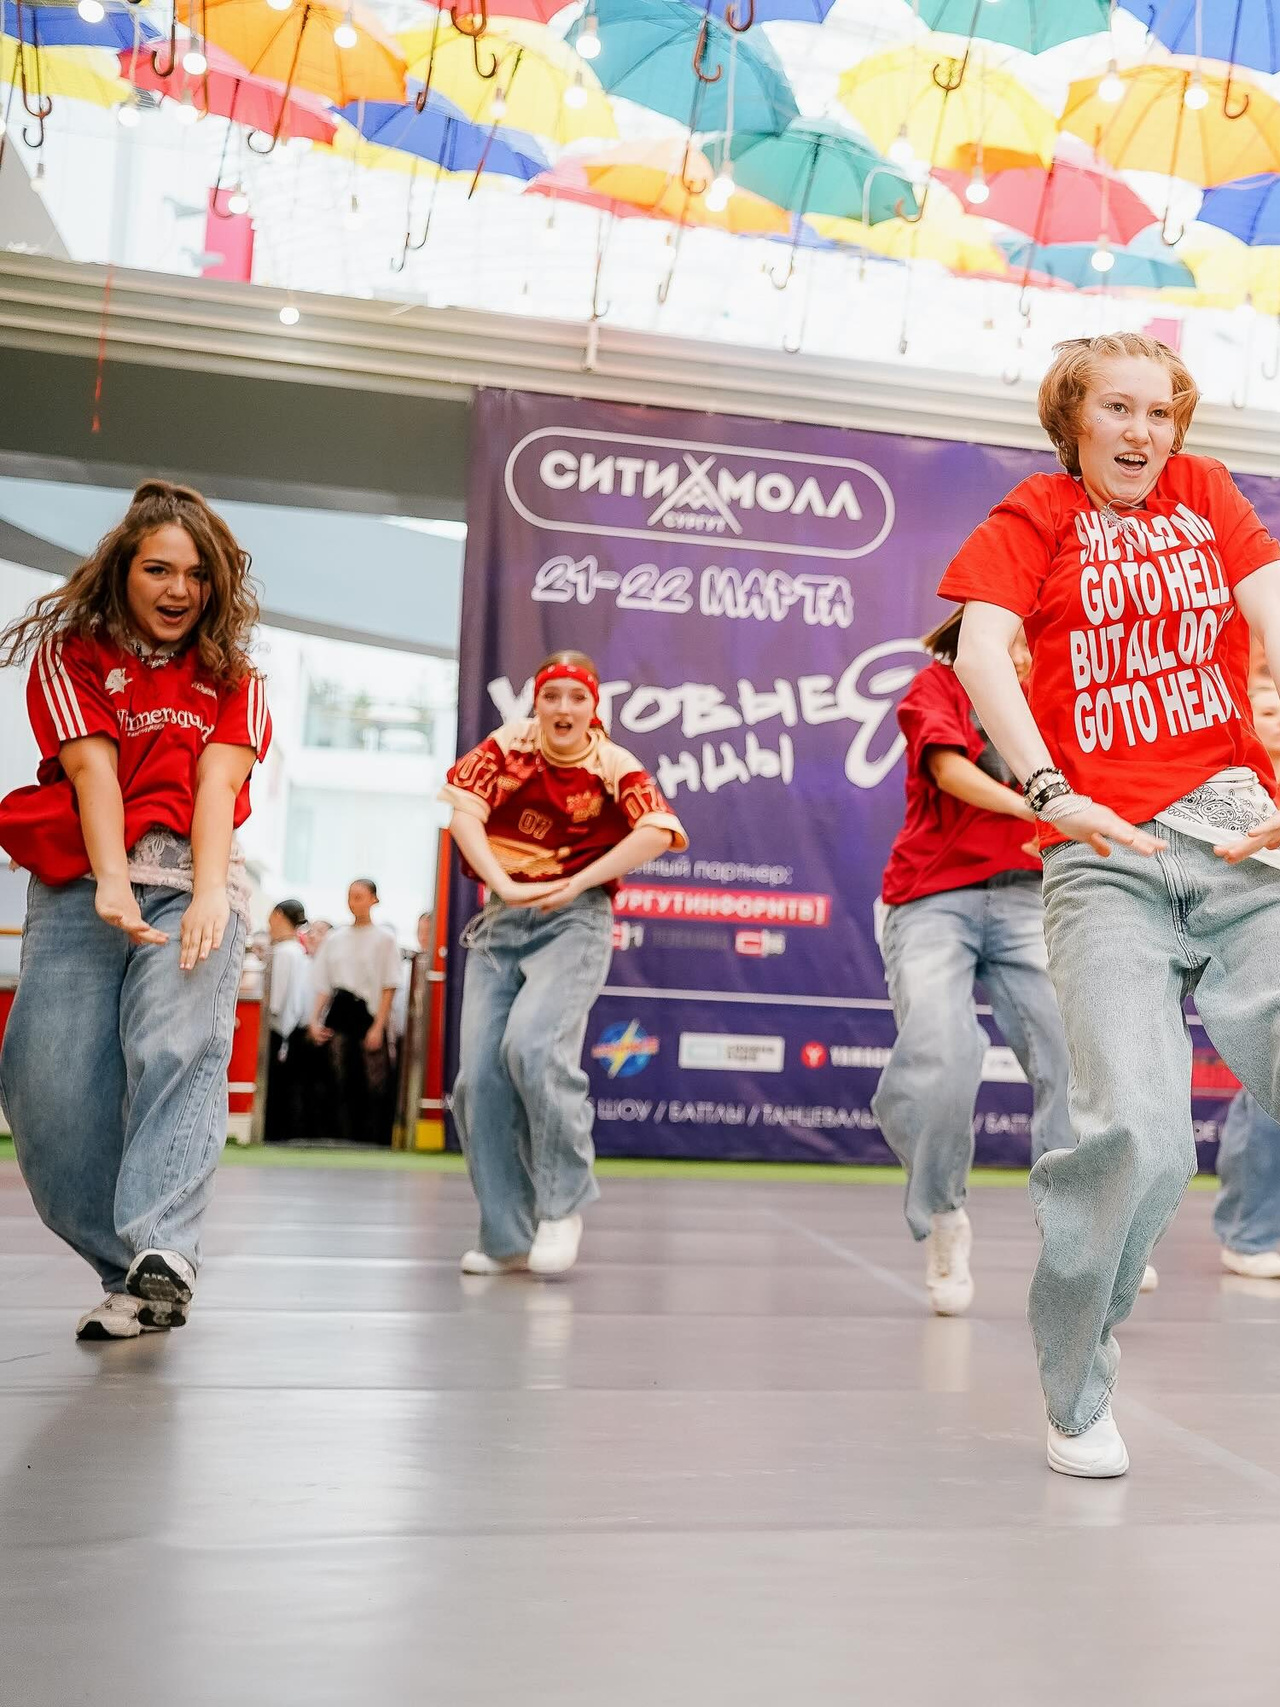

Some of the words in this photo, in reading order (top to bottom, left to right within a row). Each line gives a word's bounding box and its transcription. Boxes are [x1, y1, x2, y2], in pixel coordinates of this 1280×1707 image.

[539, 450, 679, 499] СИТИ
[717, 466, 863, 520] МОЛЛ
[531, 555, 694, 614] 21-22
[700, 565, 855, 629] МАРТА
[1080, 563, 1125, 626] GO
[1122, 560, 1163, 616] TO
[1162, 544, 1230, 612] HELL
[1069, 623, 1125, 691] BUT
[1126, 618, 1178, 679] ALL
[1178, 605, 1235, 666] DO
[1074, 690, 1115, 754] GO
[1111, 681, 1158, 747] TO
[656, 731, 794, 800] НЦЫ
